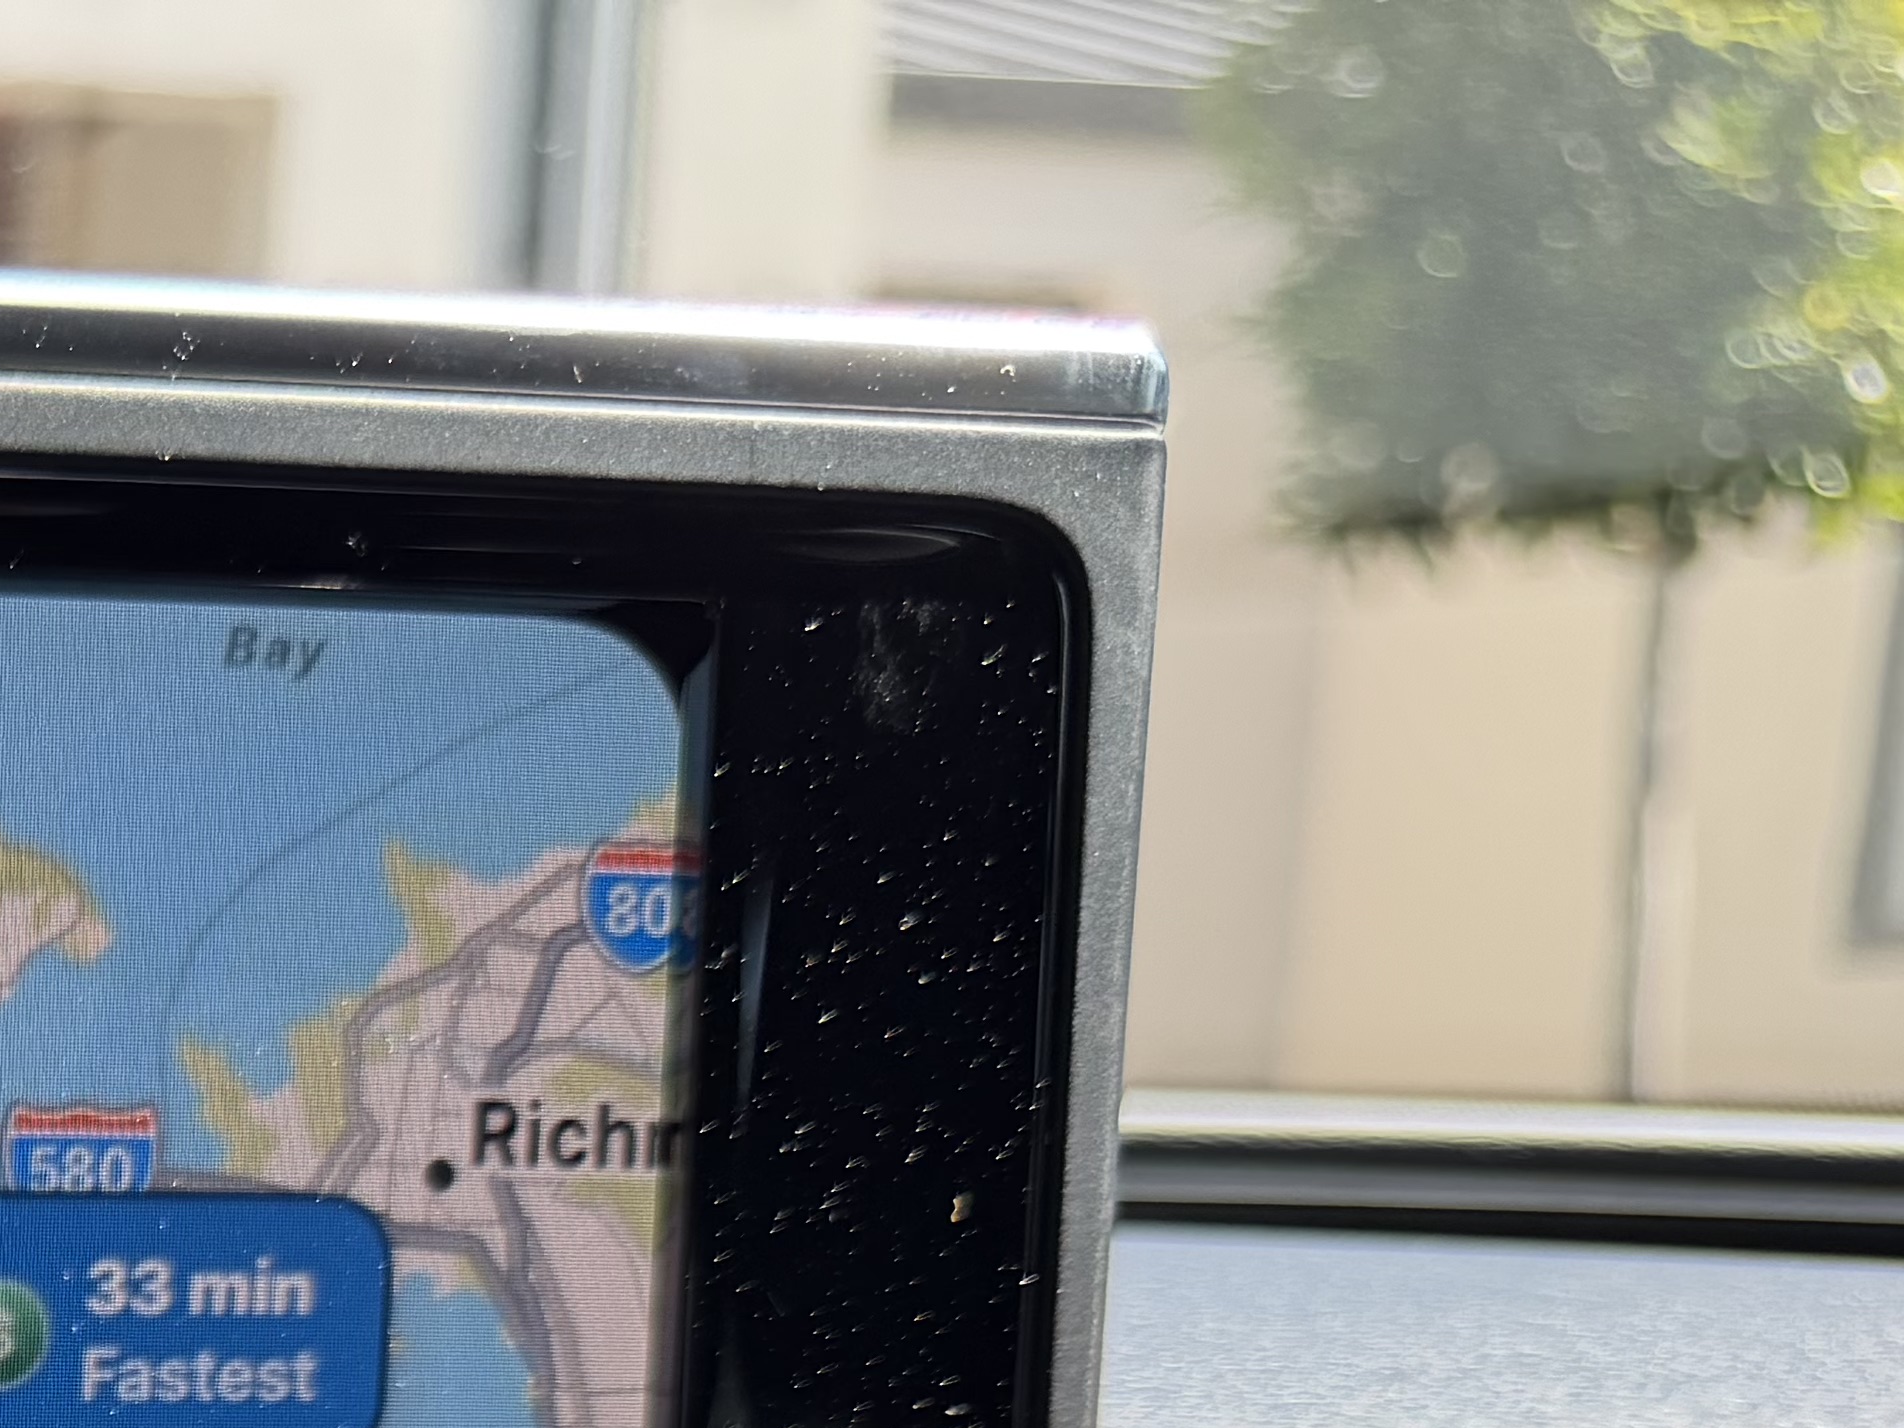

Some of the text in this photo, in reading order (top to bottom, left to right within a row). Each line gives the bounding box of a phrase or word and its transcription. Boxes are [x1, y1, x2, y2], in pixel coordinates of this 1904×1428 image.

[223, 624, 328, 681] Bay
[606, 884, 670, 938] 80
[30, 1145, 134, 1193] 580
[87, 1255, 315, 1317] 33 min
[82, 1344, 318, 1403] Fastest
